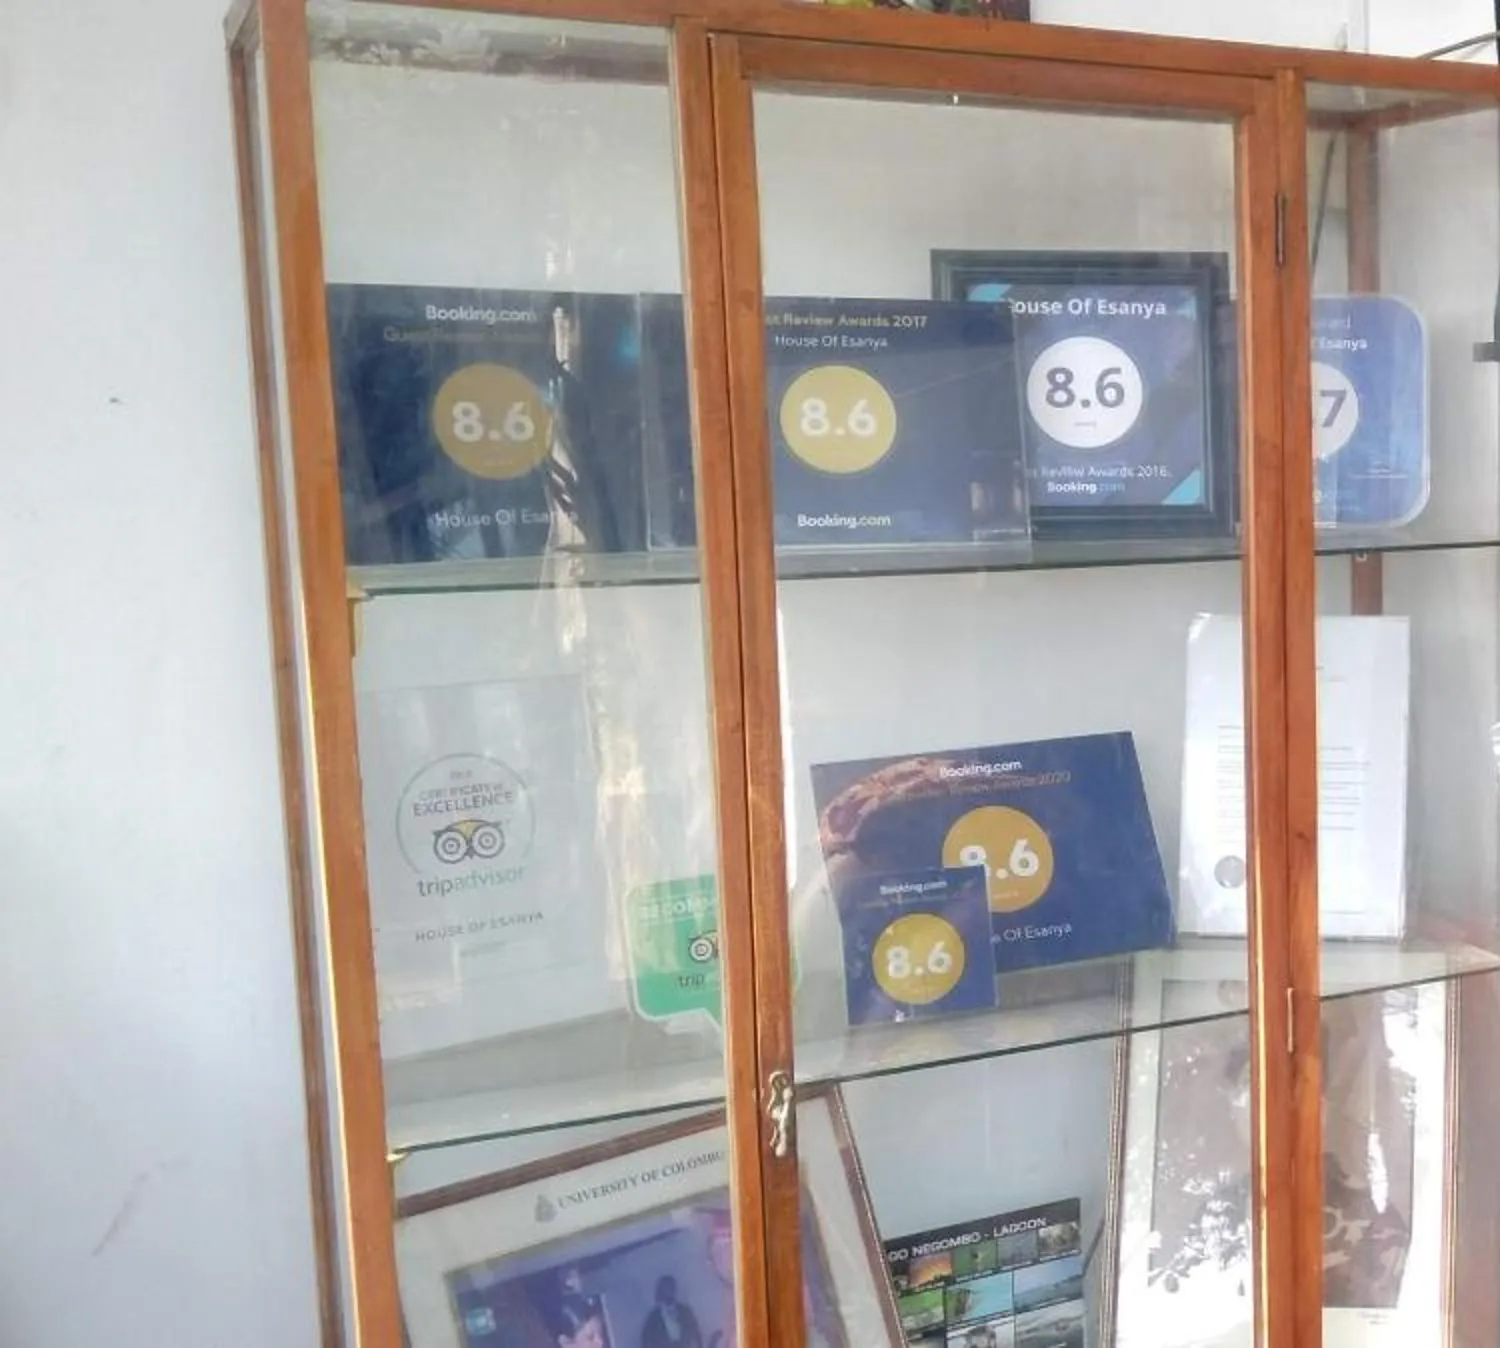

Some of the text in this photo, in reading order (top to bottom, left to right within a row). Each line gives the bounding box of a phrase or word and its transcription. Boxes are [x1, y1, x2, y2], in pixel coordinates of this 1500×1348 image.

[425, 304, 538, 326] Booking.com
[1008, 298, 1167, 319] ouse Of Esanya
[892, 314, 929, 330] 2017
[775, 334, 889, 351] House Of Esanya
[1045, 367, 1126, 409] 8.6
[452, 401, 535, 443] 8.6
[801, 397, 877, 437] 8.6
[797, 512, 892, 529] Booking.com
[939, 760, 1023, 780] Booking.com
[413, 790, 514, 818] EXCELLENCE
[1025, 922, 1073, 940] Esanya
[887, 940, 953, 980] 8.6
[557, 1173, 640, 1210] UNIVERSITY
[641, 1169, 661, 1184] OF
[911, 1230, 982, 1258] NEGOMBO
[992, 1216, 1048, 1238] LAGOON
